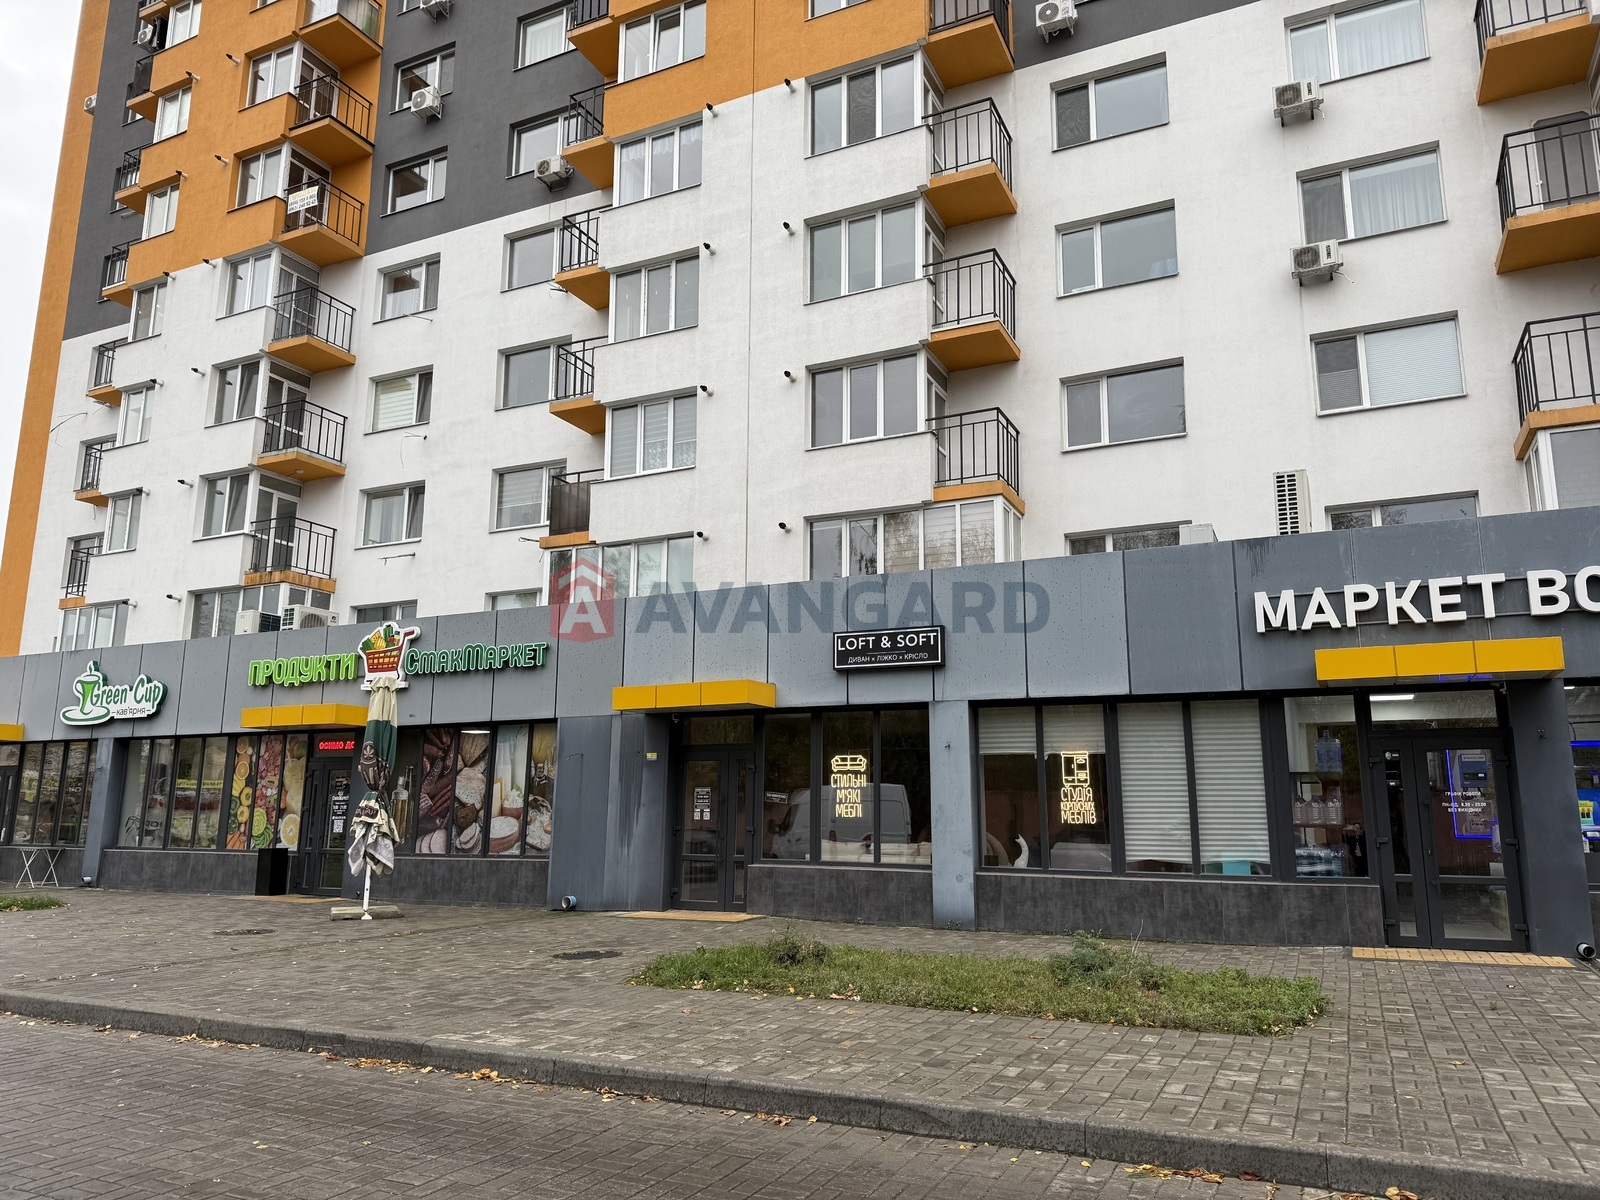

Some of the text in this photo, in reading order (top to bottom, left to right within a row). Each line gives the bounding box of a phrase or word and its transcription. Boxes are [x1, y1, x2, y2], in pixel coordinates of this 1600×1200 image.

[1253, 572, 1506, 633] МАРКЕТ
[838, 632, 938, 651] LOFT & SOFT
[847, 655, 871, 664] ДИВАН
[876, 654, 898, 662] ЛІЖКО
[904, 652, 929, 661] КРІСЛО
[248, 652, 357, 687] ПРОДУКТИ
[90, 677, 161, 710] Green Cup
[830, 773, 867, 788] СТИЛЬНІ
[836, 788, 861, 803] М'ЯКІ
[1060, 787, 1093, 802] СТУДІЯ
[835, 803, 862, 818] МЕБЛІ
[1060, 810, 1097, 825] МЕБЛІВ
